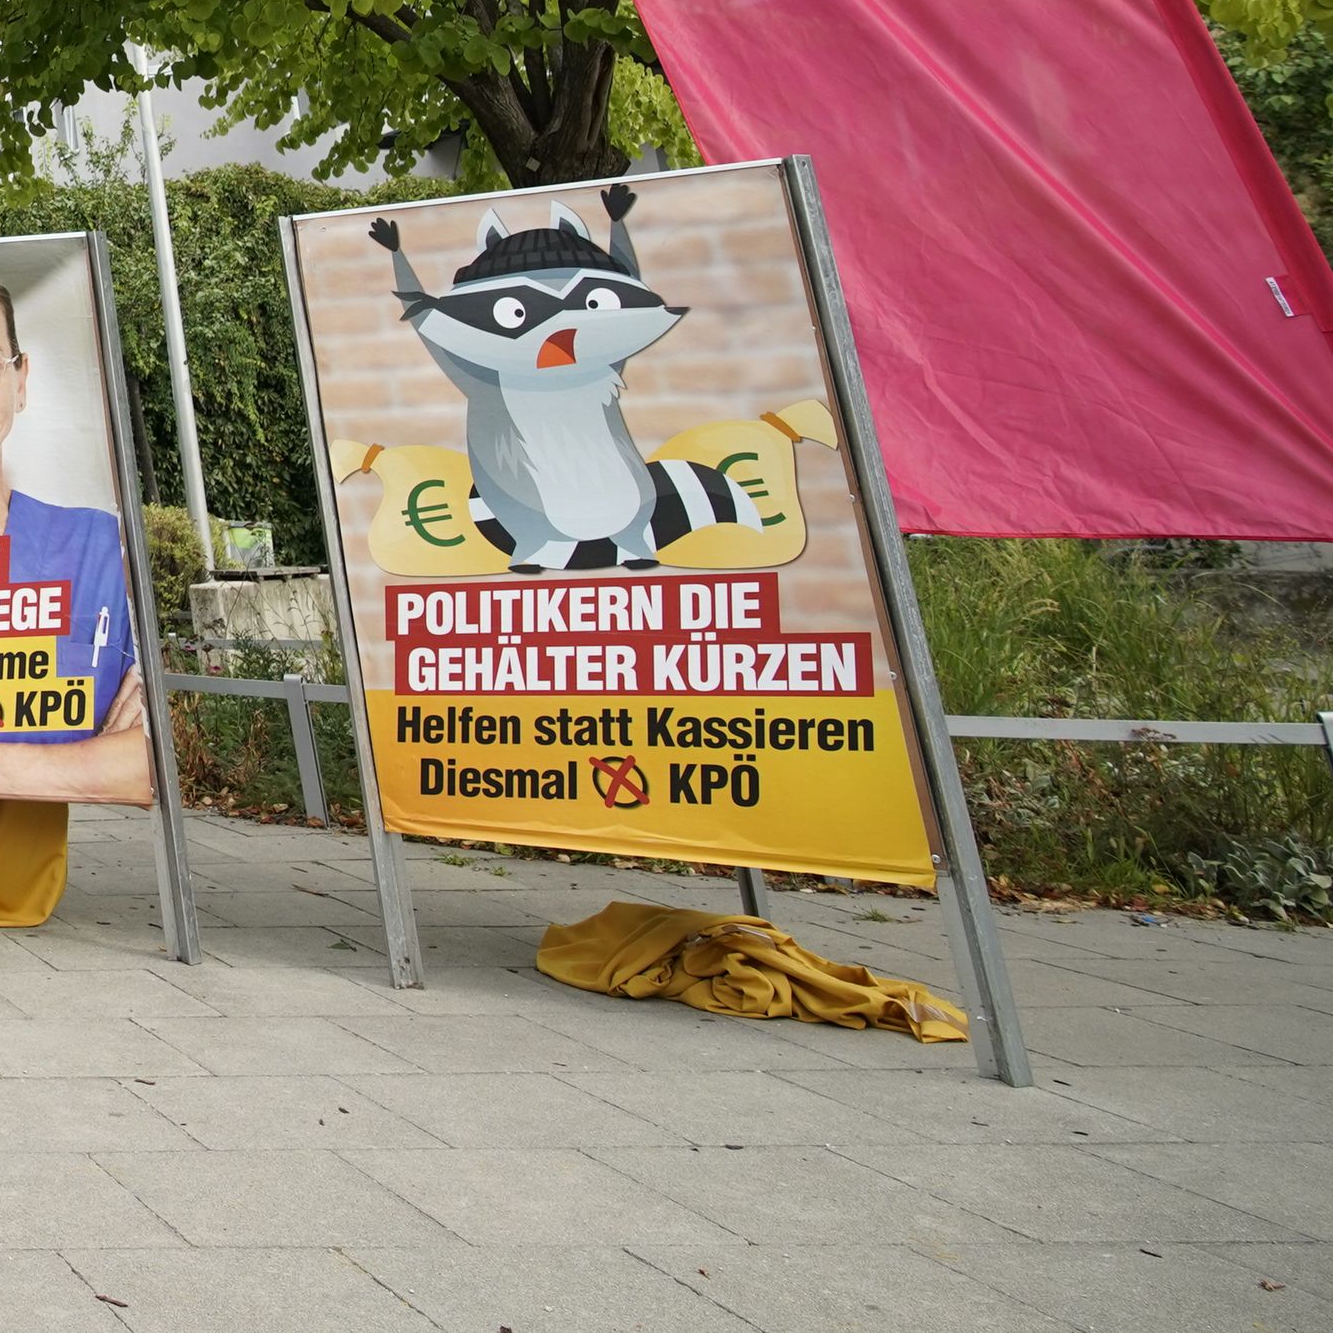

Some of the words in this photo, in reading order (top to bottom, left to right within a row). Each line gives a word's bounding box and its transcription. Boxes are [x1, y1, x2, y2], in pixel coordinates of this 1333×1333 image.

[397, 584, 663, 635] POLITIKERN
[679, 582, 761, 629] DIE
[407, 635, 638, 692] GEHÄLTER
[653, 632, 857, 692] KÜRZEN
[14, 679, 85, 727] KPÖ
[397, 706, 521, 745] Helfen
[534, 708, 633, 746] statt
[647, 707, 874, 752] Kassieren
[420, 758, 577, 800] Diesmal
[669, 754, 760, 807] KPÖ
